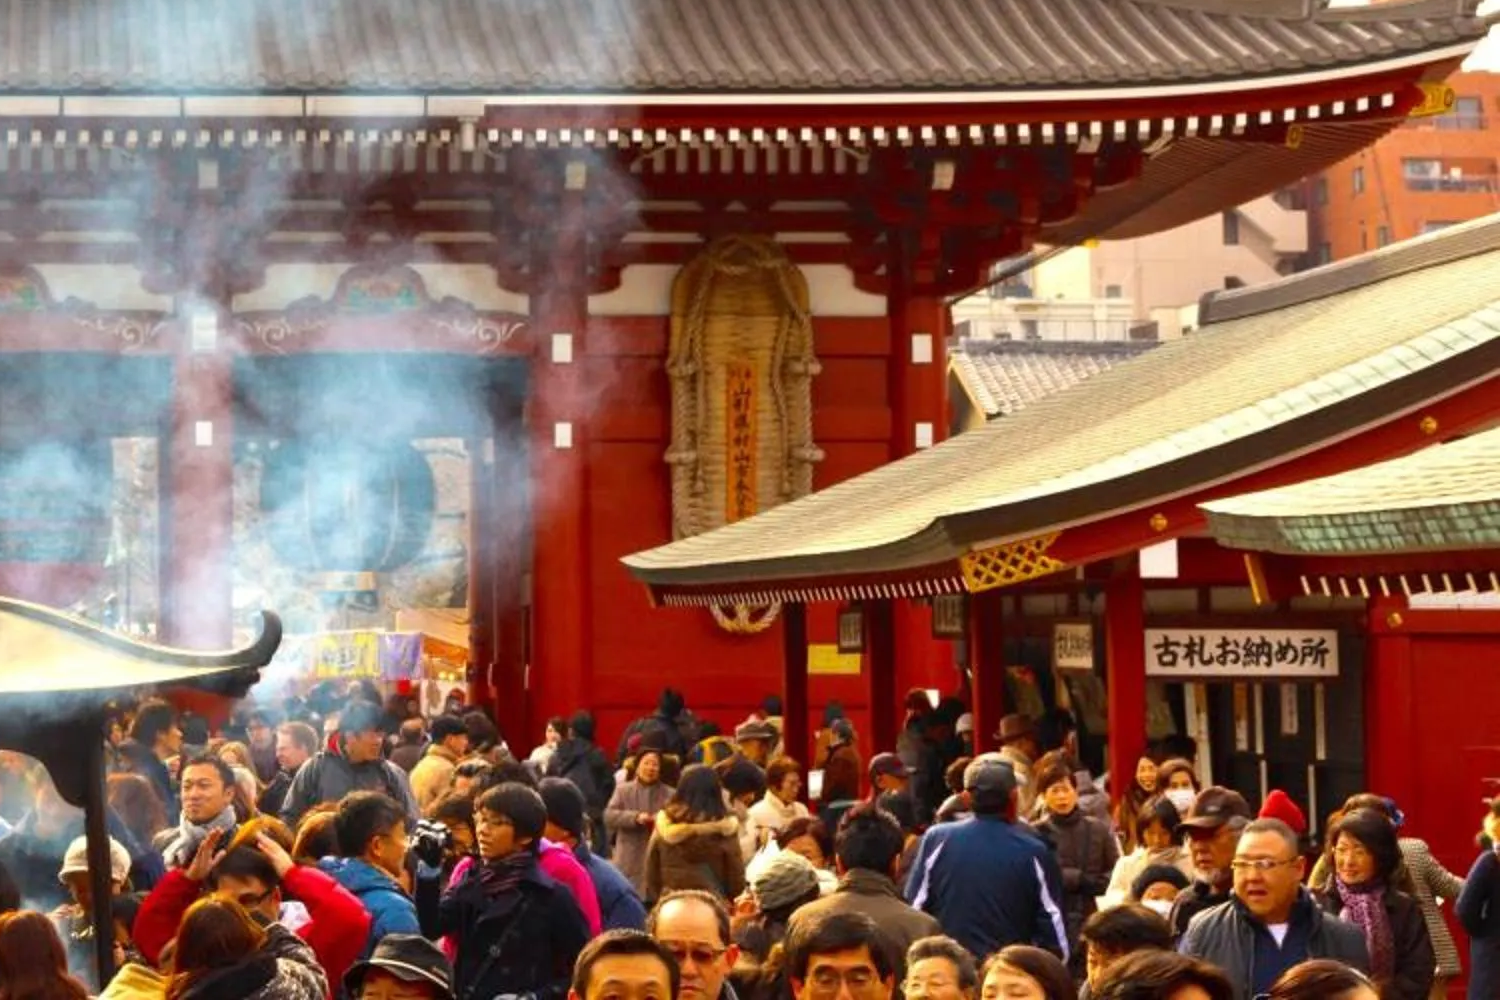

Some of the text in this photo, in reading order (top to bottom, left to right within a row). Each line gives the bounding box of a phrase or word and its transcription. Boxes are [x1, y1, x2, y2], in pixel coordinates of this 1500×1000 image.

[1153, 635, 1330, 669] 古札お納め所
